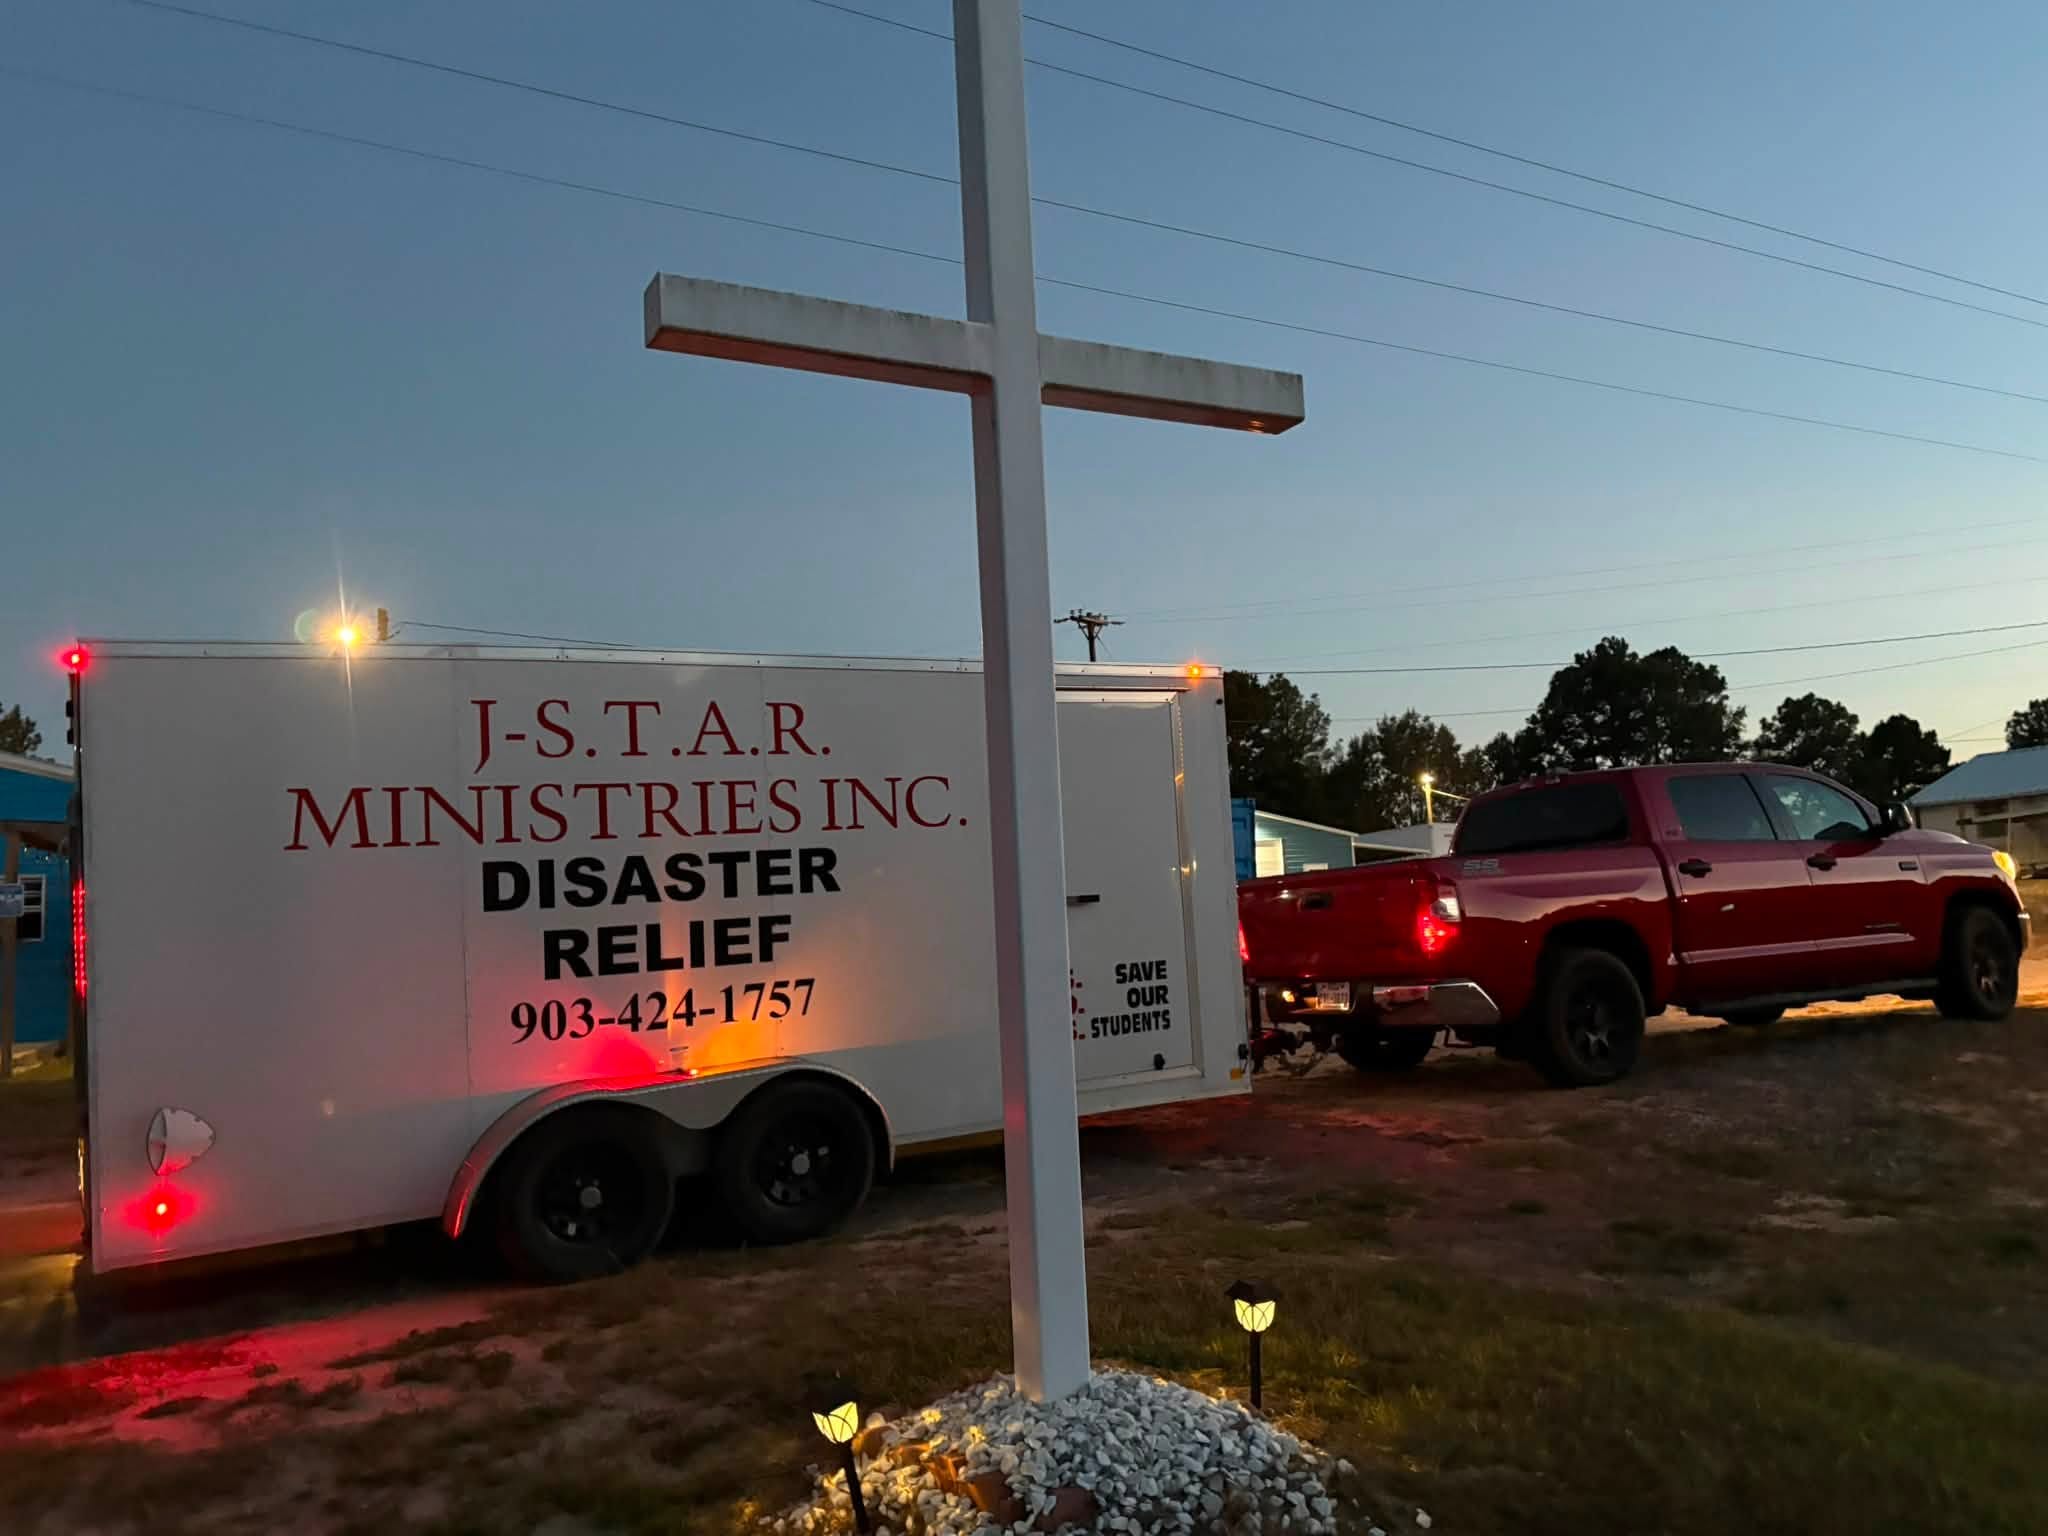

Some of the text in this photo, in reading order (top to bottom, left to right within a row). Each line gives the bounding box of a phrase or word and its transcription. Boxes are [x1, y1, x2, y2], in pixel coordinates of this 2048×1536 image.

[284, 775, 969, 851] MINISTRIES INC.
[482, 847, 840, 912] DISASTER
[544, 915, 792, 979] RELIEF
[1115, 960, 1167, 984] SAVE
[511, 979, 816, 1045] 903-424-1757
[1091, 1009, 1170, 1039] STUDENTS
[1127, 985, 1169, 1008] OUR
